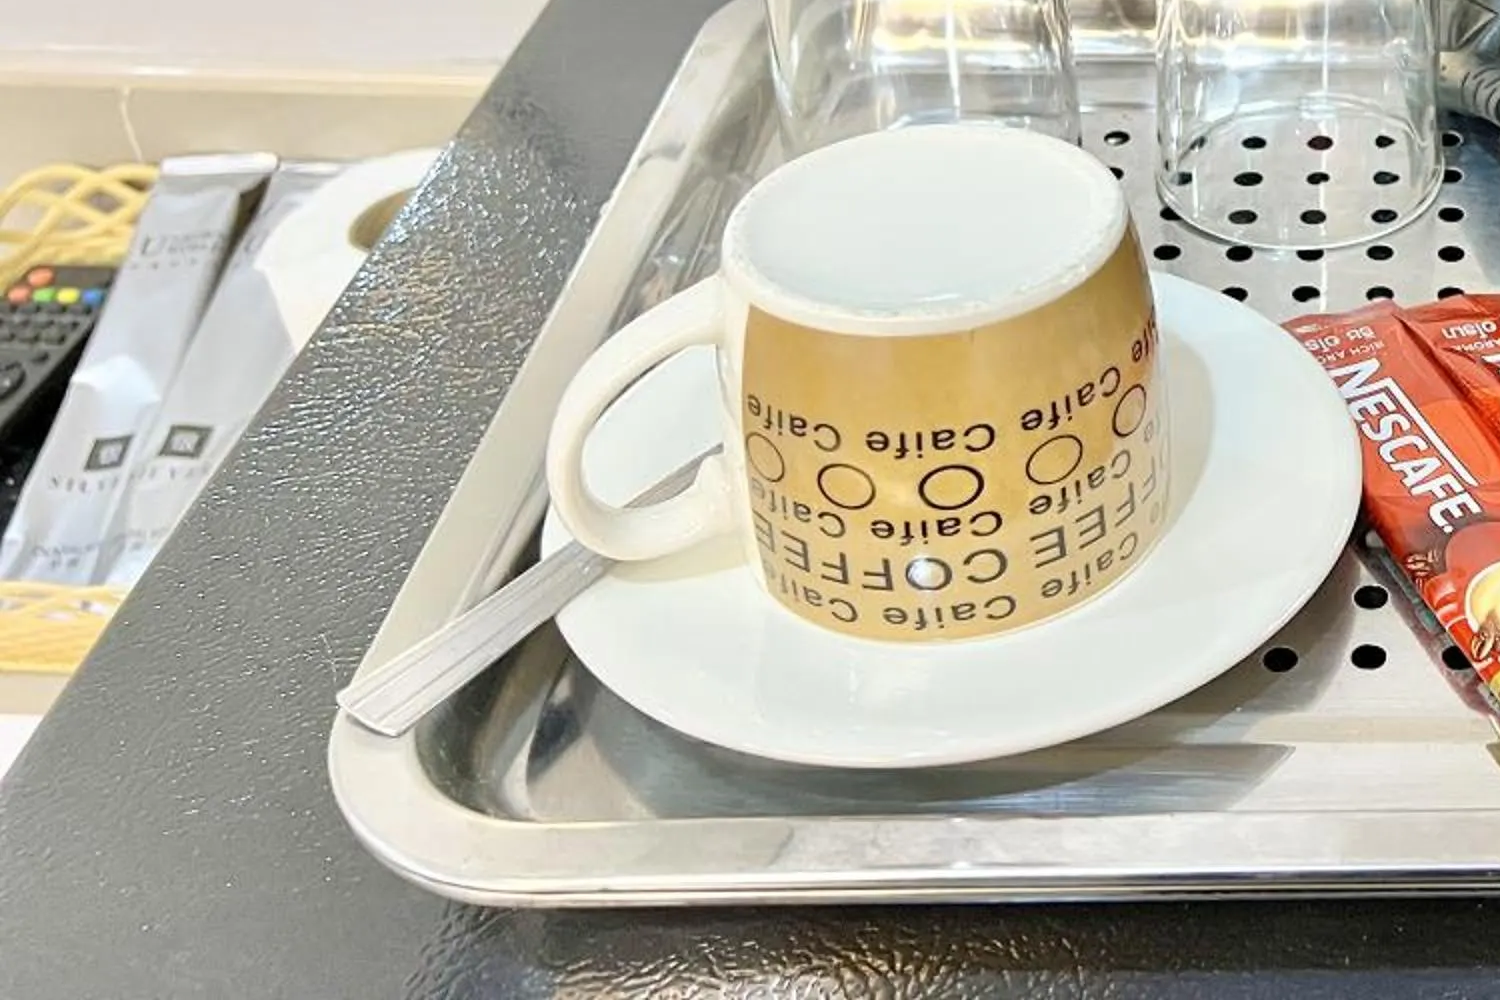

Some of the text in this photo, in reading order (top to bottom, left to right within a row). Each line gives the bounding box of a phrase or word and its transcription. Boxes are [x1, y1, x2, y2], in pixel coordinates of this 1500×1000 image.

[1317, 349, 1346, 364] ARO
[746, 393, 842, 453] Caife
[1020, 366, 1121, 432] Caife
[865, 421, 997, 460] Caife
[1027, 447, 1133, 515] Caife
[752, 510, 1009, 593] COFFEE
[869, 510, 1003, 547] Caife
[1040, 531, 1140, 601] Caife
[882, 595, 1017, 631] Caife
